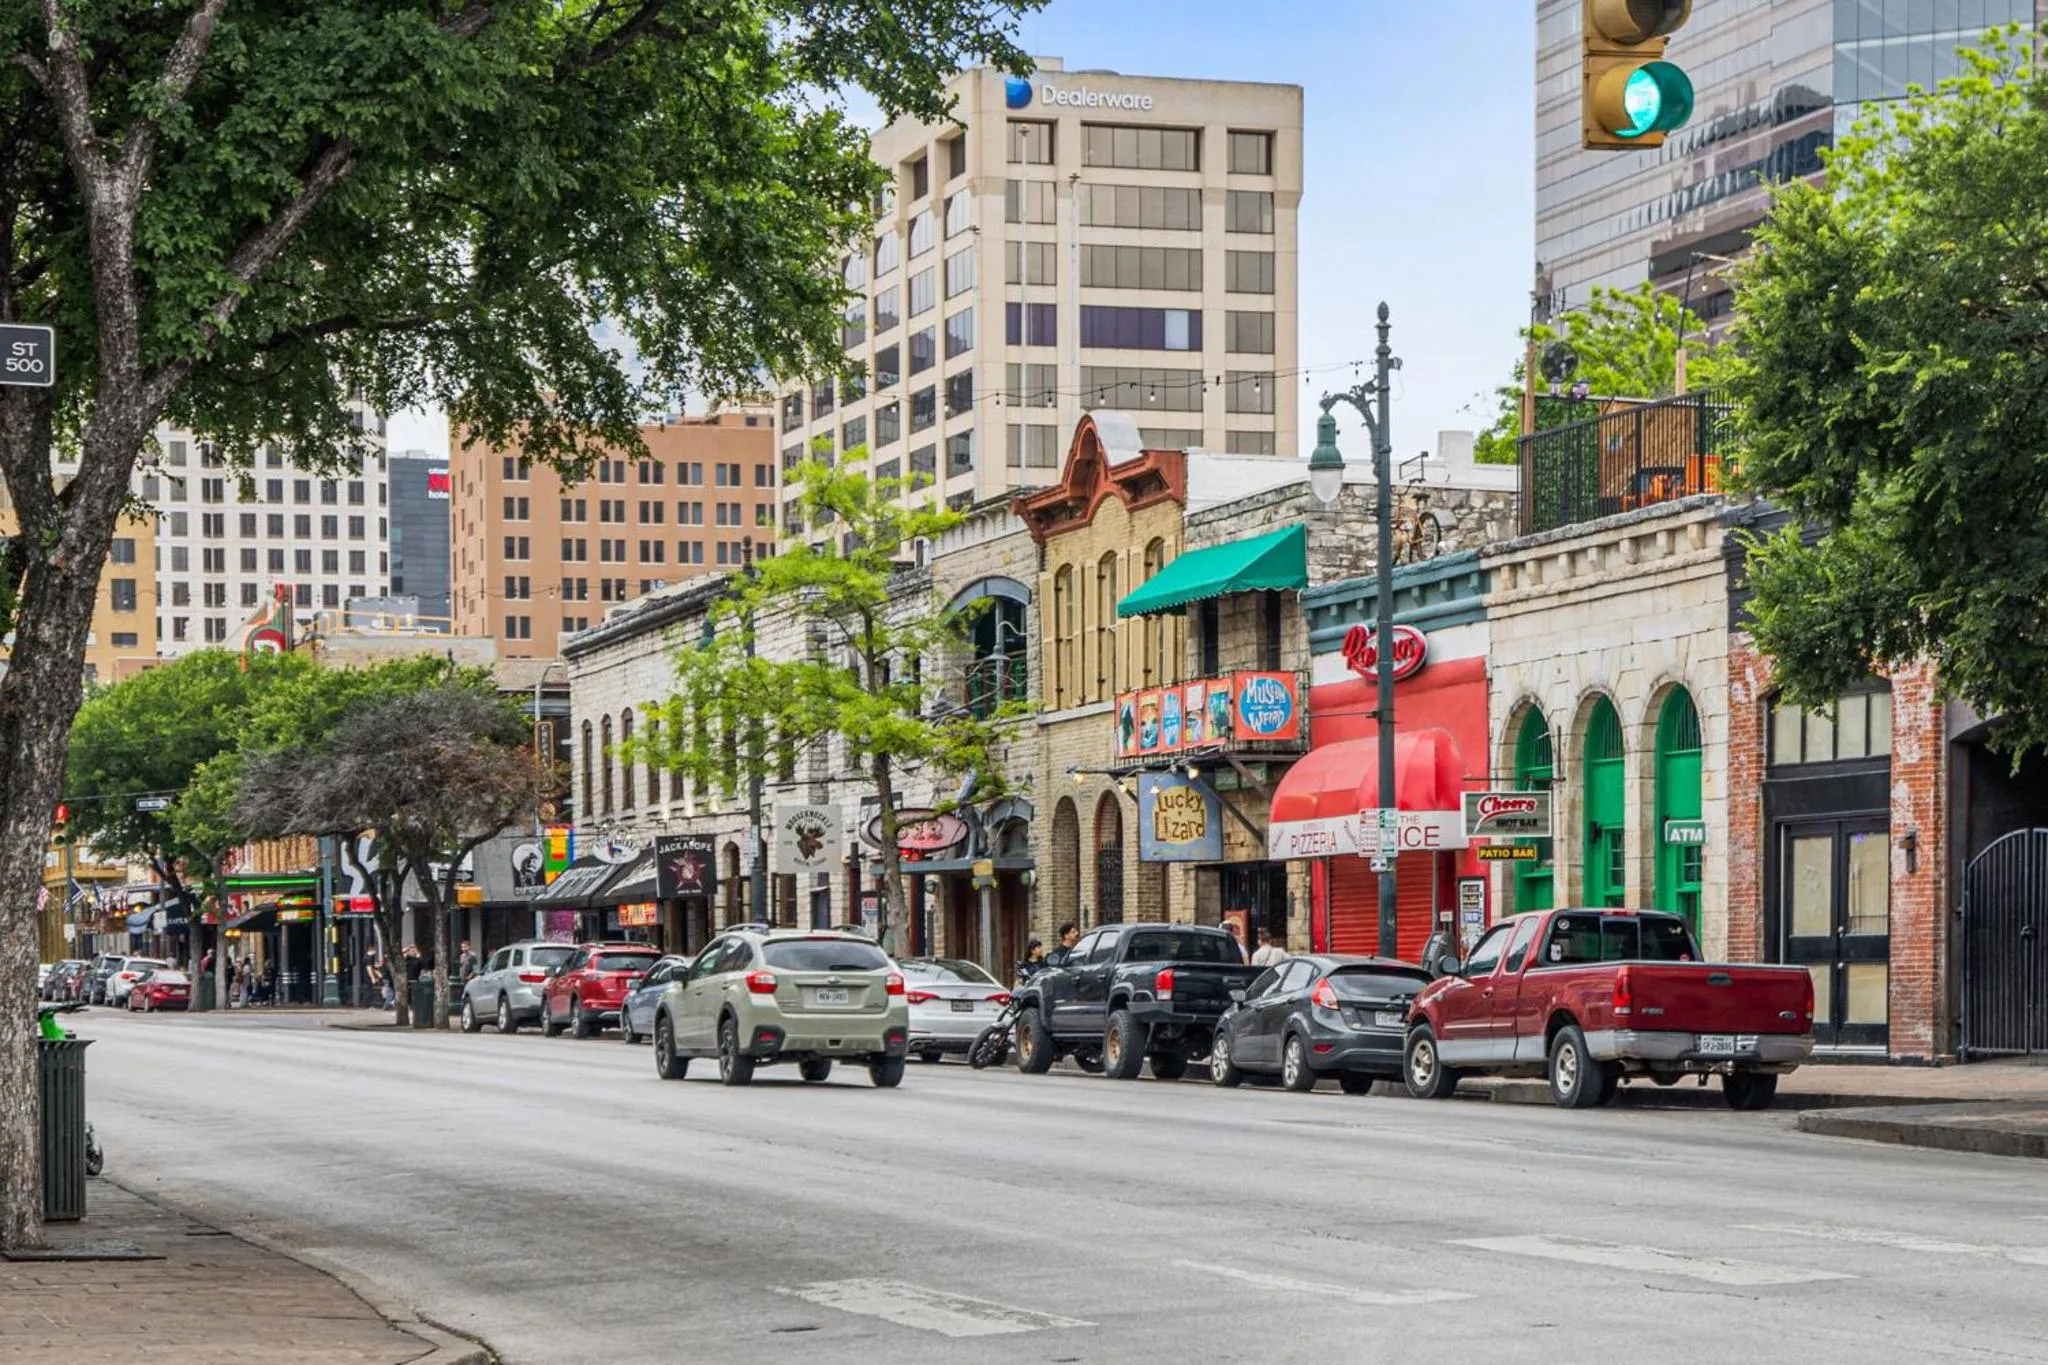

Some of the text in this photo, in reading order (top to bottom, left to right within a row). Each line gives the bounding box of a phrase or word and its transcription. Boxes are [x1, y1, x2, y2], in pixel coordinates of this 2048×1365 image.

[1041, 85, 1153, 110] Dealerware
[12, 342, 38, 357] ST
[6, 358, 43, 373] 500
[1156, 787, 1203, 812] Lucky
[1478, 796, 1537, 815] Cheers
[1400, 815, 1420, 824] THE
[1398, 826, 1441, 848] ICE
[1670, 828, 1703, 841] ATM
[659, 840, 713, 854] JACKALOPE
[1291, 831, 1338, 855] PIZZERIA
[1480, 849, 1534, 857] PATIO BAR
